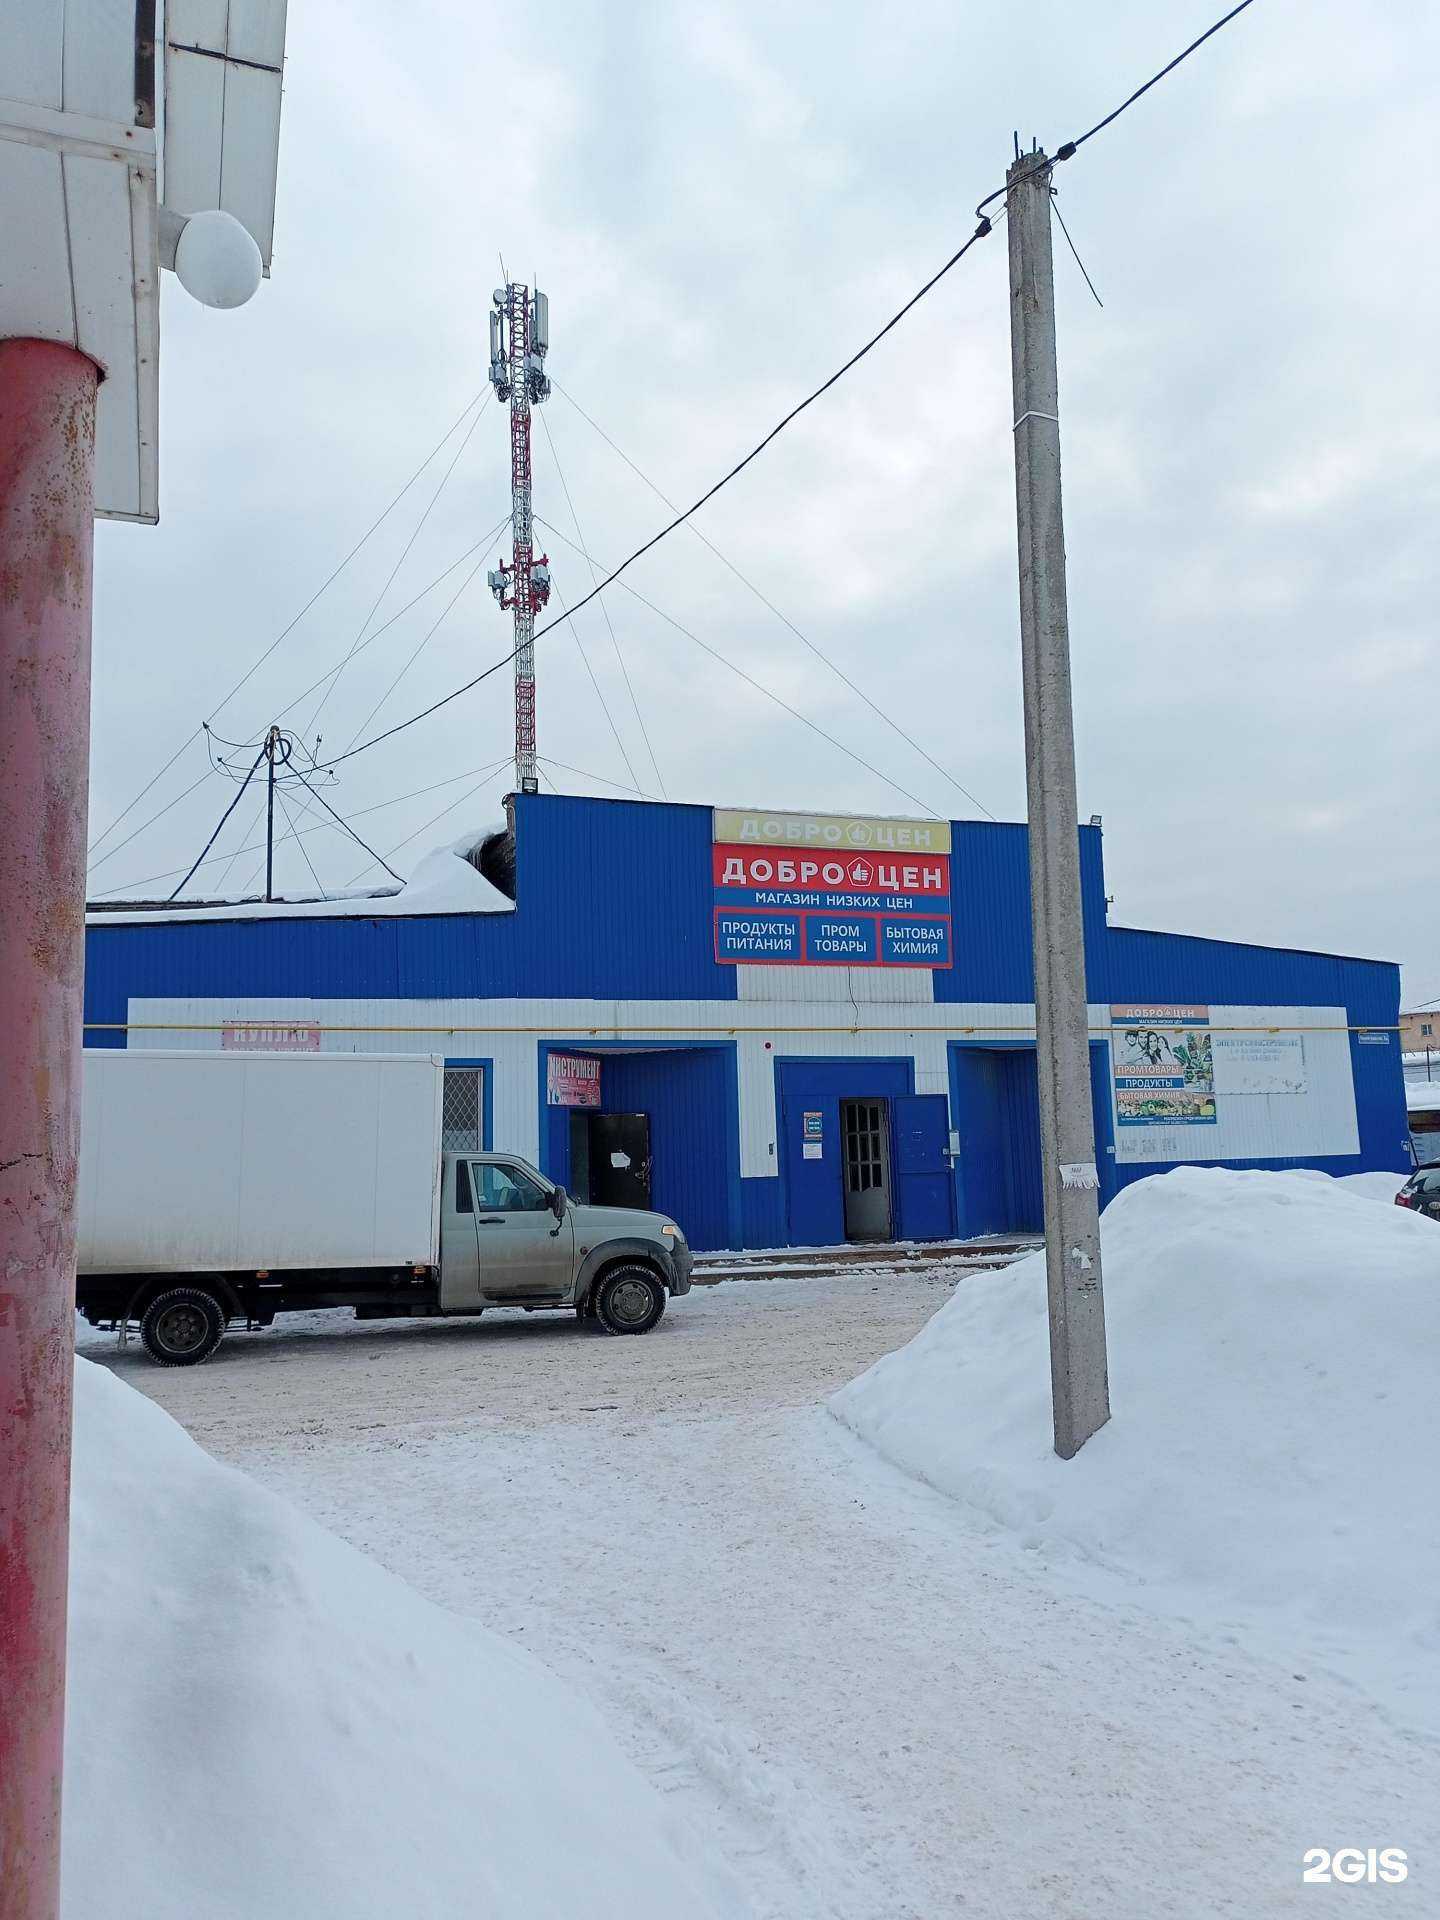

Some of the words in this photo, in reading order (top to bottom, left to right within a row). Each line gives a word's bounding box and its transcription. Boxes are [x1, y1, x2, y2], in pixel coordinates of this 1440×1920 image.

[739, 819, 842, 842] ДОБРО
[877, 827, 930, 847] ЦЕН
[722, 858, 844, 885] ДОБРО
[879, 865, 941, 890] ЦЕН
[755, 892, 819, 905] МАГАЗИН
[826, 895, 880, 907] НИЗКИХ
[887, 897, 913, 909] ЦЕН
[722, 921, 795, 936] ПРОДУКТЫ
[821, 924, 860, 937] ПРОМ
[886, 926, 943, 940] БЫТОВАЯ
[727, 937, 792, 950] ПИТАНИЯ
[815, 940, 867, 952] ТОВАРЫ
[893, 942, 938, 954] ХИМИЯ
[233, 1023, 309, 1042] КУПЛЮ
[548, 1056, 600, 1079] ИНСТРУМЕНТ
[1117, 1065, 1179, 1074] ПРОМТОВАРЫ
[1125, 1079, 1173, 1089] ПРОДУКТЫ
[1119, 1092, 1153, 1100] БЫТОВАЯ
[1154, 1091, 1180, 1099] ХИМИЯ
